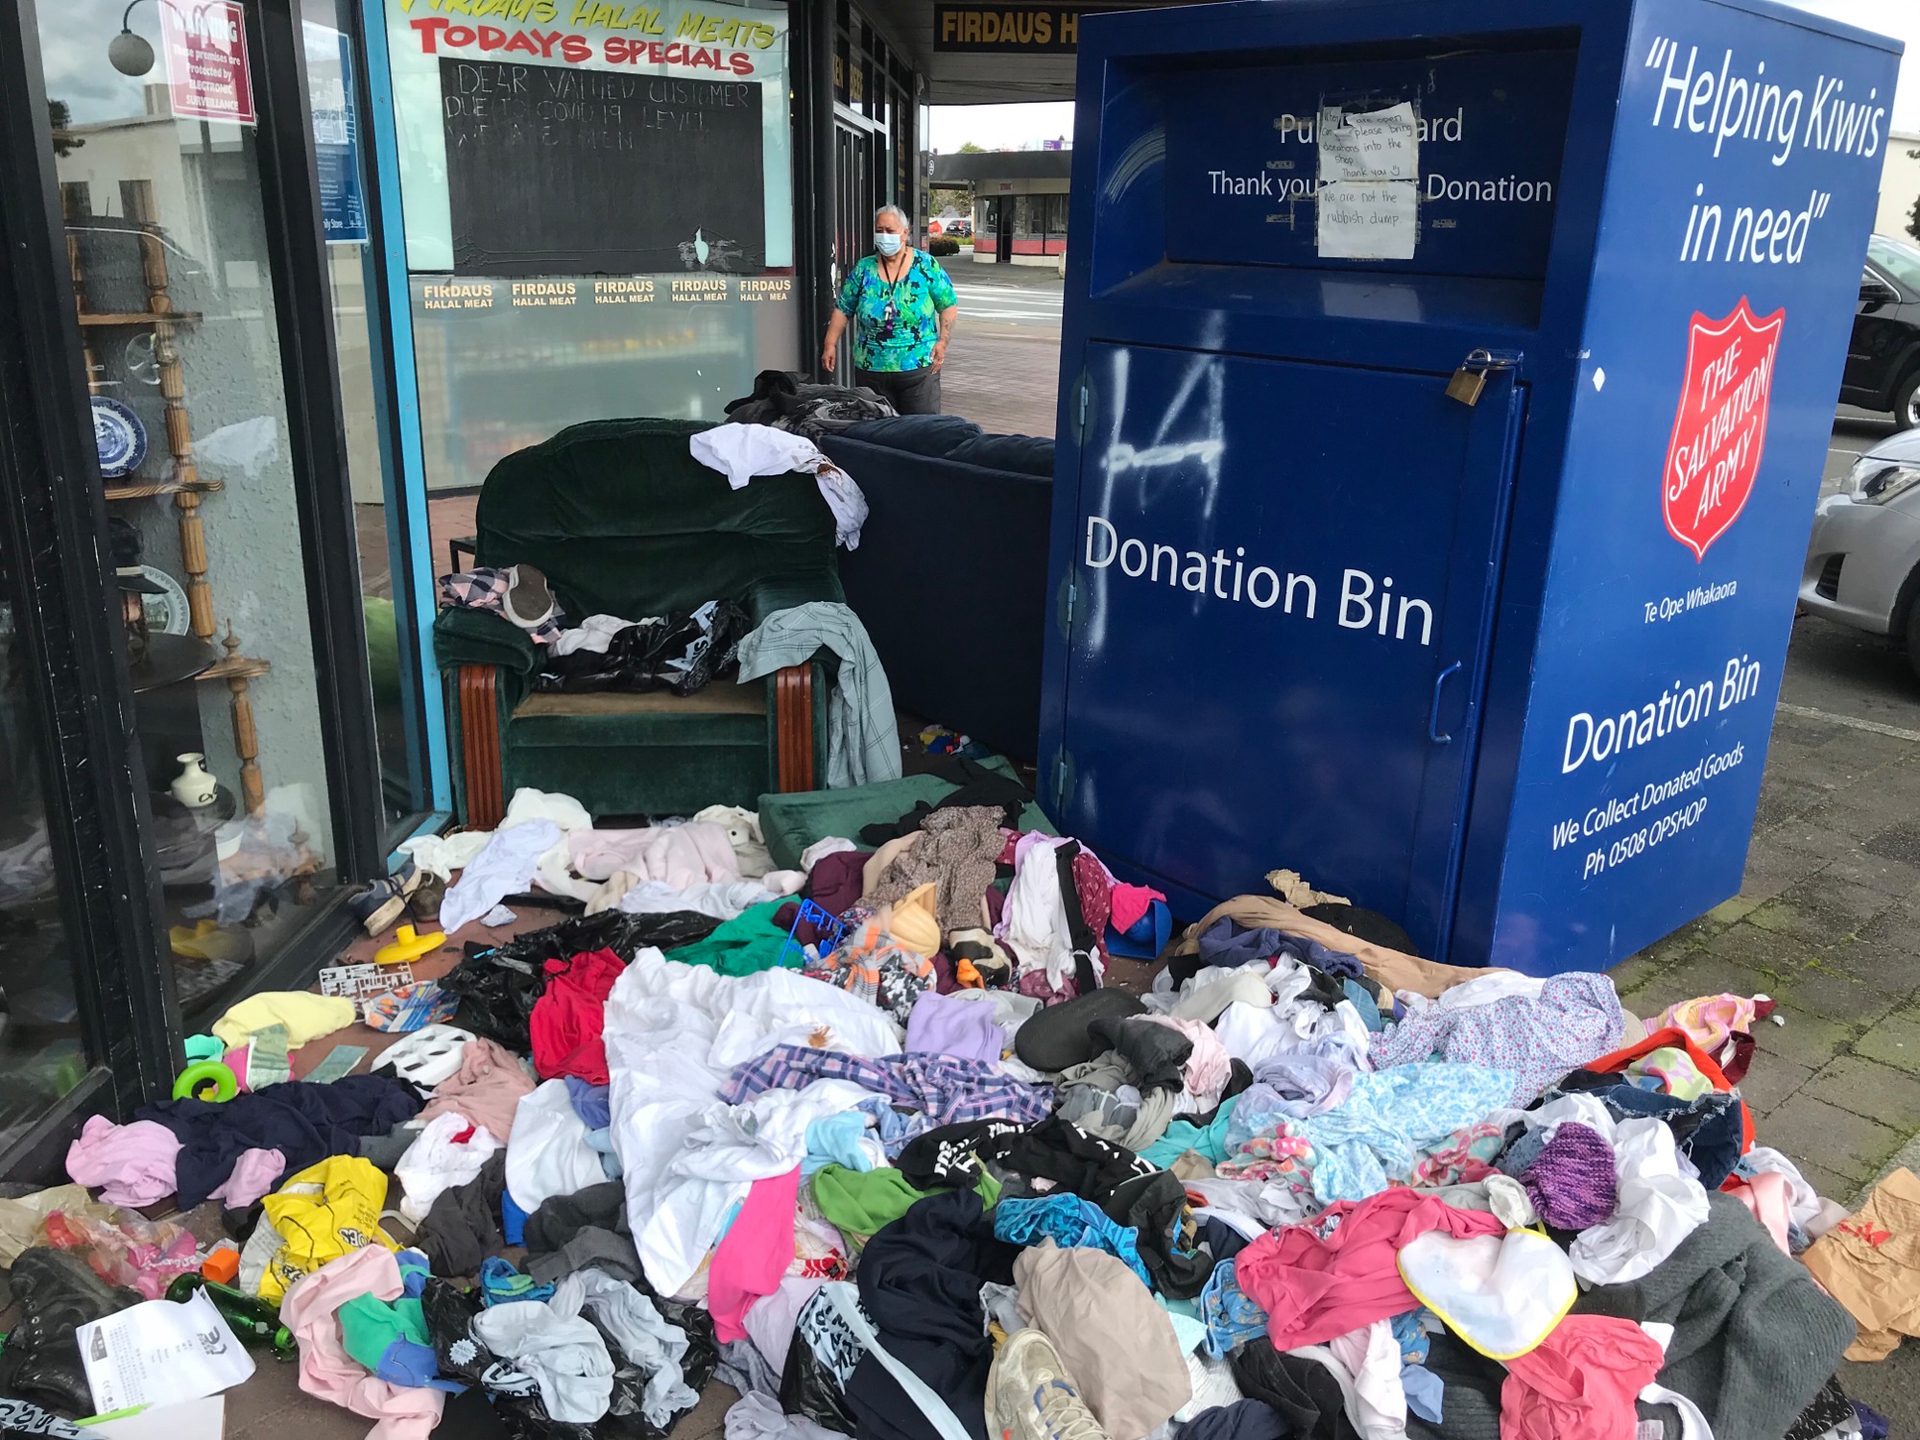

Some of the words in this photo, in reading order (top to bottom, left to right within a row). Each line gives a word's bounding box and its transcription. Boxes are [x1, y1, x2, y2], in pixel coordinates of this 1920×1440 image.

[569, 0, 665, 35] HALAL
[675, 10, 776, 49] MEATS
[942, 11, 1052, 44] FIRDAUS
[196, 49, 227, 63] premises
[229, 55, 240, 65] are
[410, 17, 592, 63] TODAYS
[603, 37, 755, 75] SPECIALS
[189, 79, 232, 94] ELECTRONIC
[223, 68, 232, 81] by
[458, 64, 528, 94] DEAR
[186, 94, 238, 110] SURVEILLANCE
[1377, 114, 1402, 123] open
[1804, 75, 1884, 157] Kiwis
[1355, 127, 1382, 139] please
[1389, 125, 1412, 137] bring
[1323, 142, 1359, 152] donations
[1364, 141, 1381, 152] into
[1388, 138, 1401, 149] the
[1342, 168, 1367, 177] Thank
[1371, 169, 1387, 178] you
[1208, 171, 1272, 195] Thank
[1427, 174, 1552, 202] Donation
[1362, 190, 1376, 202] not
[1382, 190, 1397, 203] the
[1327, 210, 1363, 224] rubbish
[1681, 184, 1719, 262] in
[424, 285, 493, 298] FIRDAUS
[512, 282, 576, 296] FIRDAUS
[594, 280, 654, 294] FIRDAUS
[671, 280, 727, 292] FIRDAUS
[740, 280, 791, 292] FIRDAUS
[595, 295, 627, 305] HALAL
[629, 294, 655, 304] MEAT
[672, 293, 701, 302] HALAL
[704, 293, 727, 302] MEAT
[425, 300, 461, 309] HALAL
[464, 299, 493, 308] MEAT
[512, 297, 546, 307] HALAL
[549, 296, 576, 306] MEAT
[1700, 336, 1743, 413] THE
[1669, 343, 1772, 502] SALVATION
[1692, 415, 1757, 530] ARMY
[1085, 515, 1317, 619] Donation
[1338, 568, 1433, 646] Bin
[1644, 602, 1657, 623] Te
[1660, 597, 1684, 622] Ope
[1686, 580, 1737, 611] Whakaora
[1562, 680, 1713, 774] Donation
[1718, 654, 1760, 711] Bin
[1553, 818, 1580, 850] We
[1583, 793, 1640, 836] Collect
[1641, 763, 1702, 811] Donated
[1704, 741, 1744, 779] Goods
[1584, 848, 1604, 880] Ph
[1609, 829, 1648, 866] 0508
[1649, 797, 1708, 847] OPSHOP
